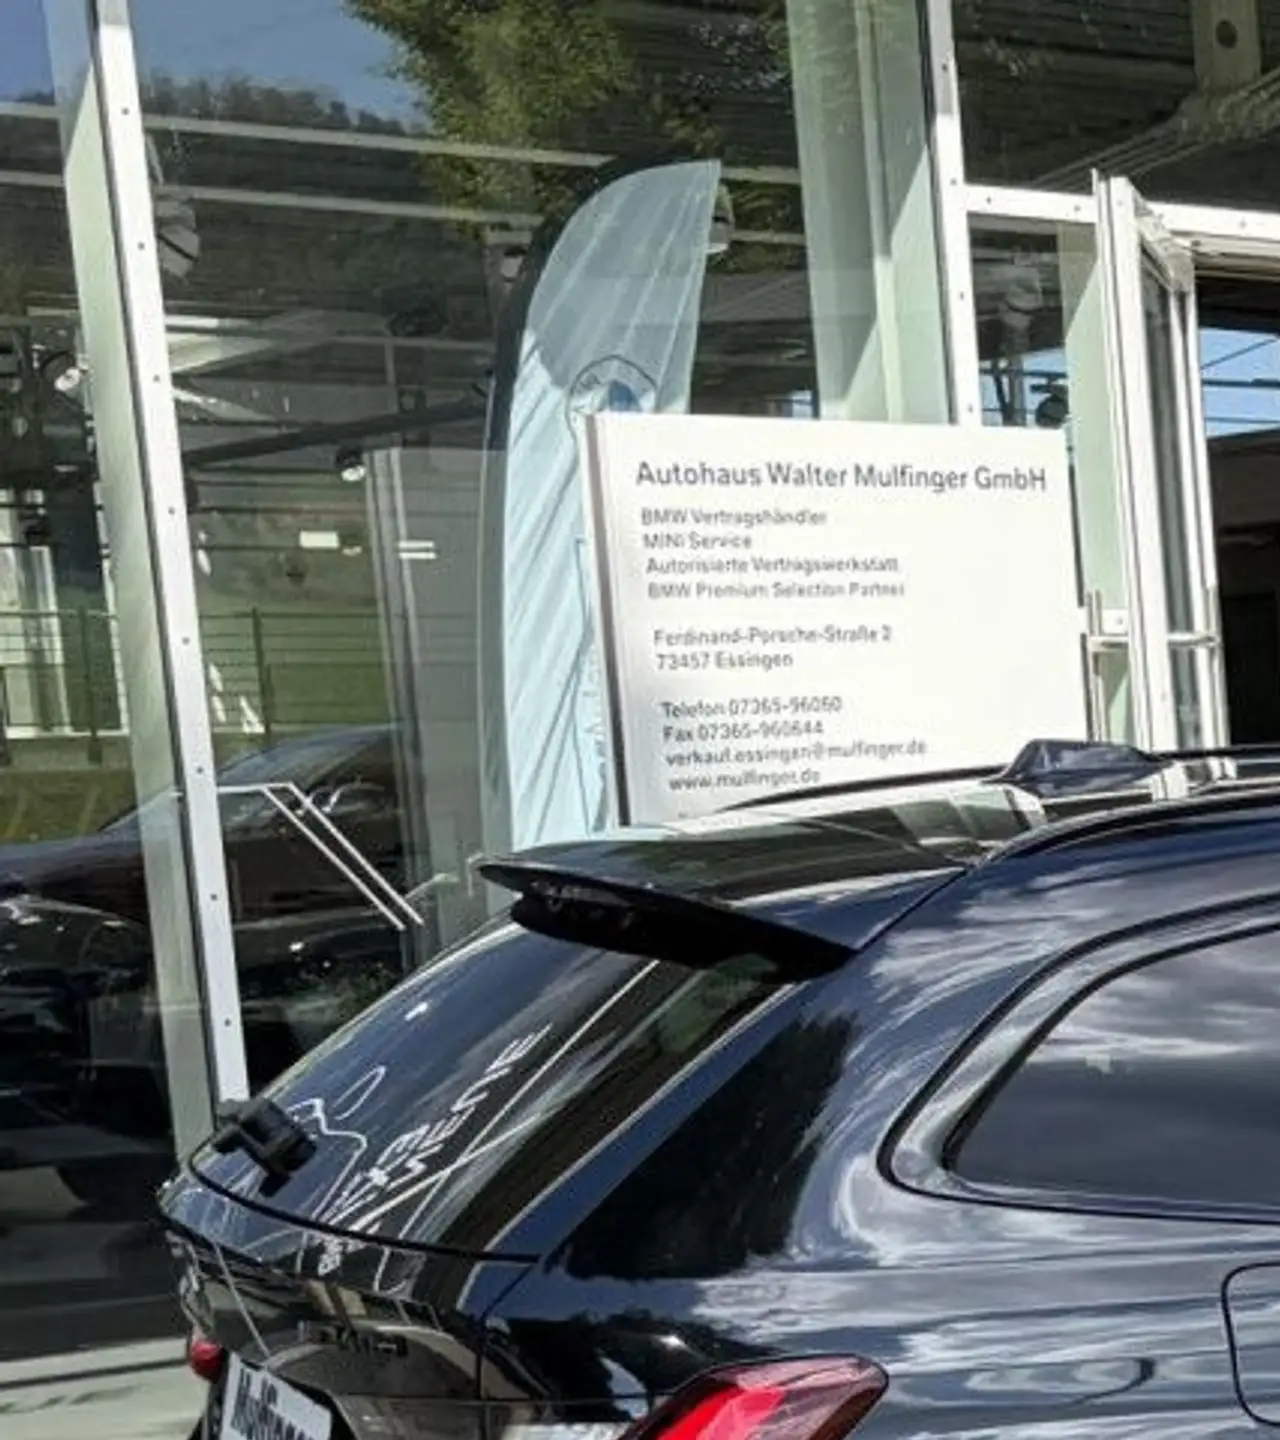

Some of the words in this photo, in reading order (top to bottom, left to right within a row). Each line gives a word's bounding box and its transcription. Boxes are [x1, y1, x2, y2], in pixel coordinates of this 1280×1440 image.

[636, 460, 762, 487] Autohaus
[766, 462, 847, 489] Walter
[853, 463, 969, 494] Mulfinger
[974, 466, 1047, 492] GmbH
[642, 508, 687, 526] BMW
[689, 531, 752, 550] Service
[648, 581, 691, 598] BMW
[772, 580, 844, 598] Selection
[849, 581, 904, 597] Partner
[716, 651, 793, 671] Essingen
[662, 700, 727, 718] Telefon
[664, 725, 694, 743] Fax
